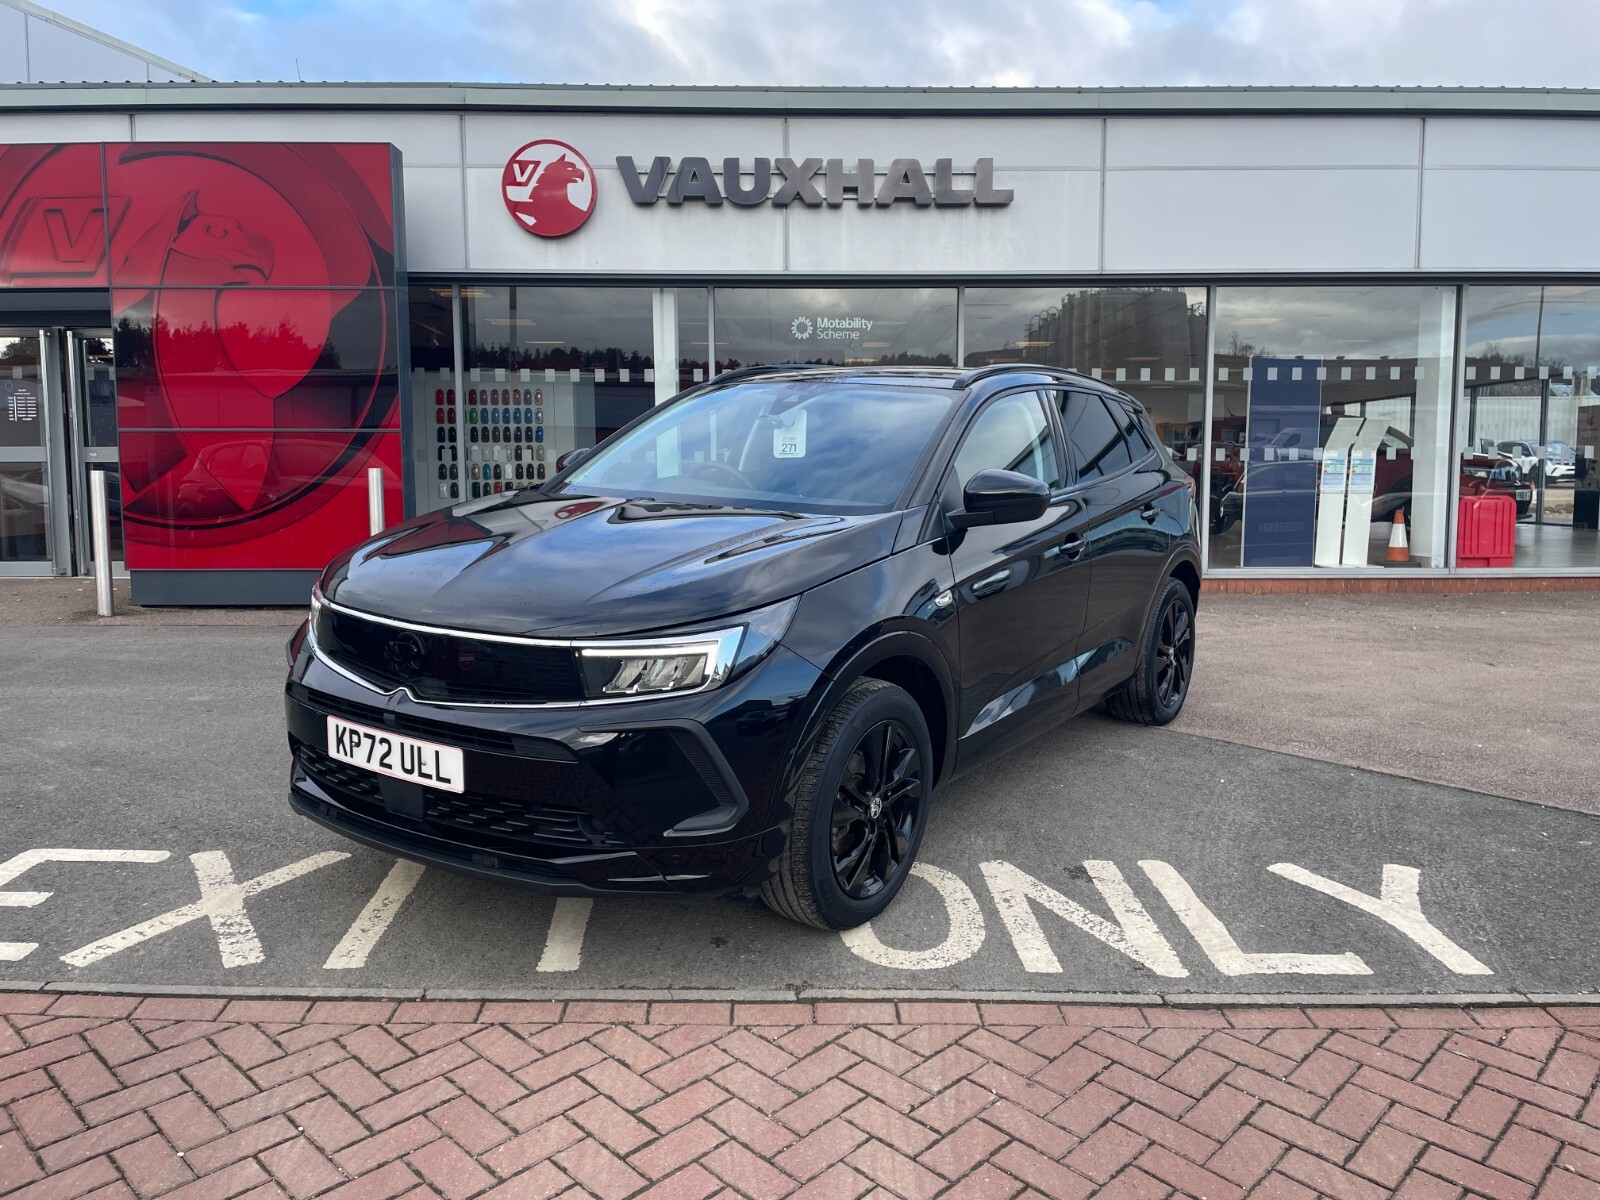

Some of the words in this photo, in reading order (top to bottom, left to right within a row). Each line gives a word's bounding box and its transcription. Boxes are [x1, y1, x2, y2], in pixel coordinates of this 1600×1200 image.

[513, 163, 535, 183] V
[615, 156, 1015, 208] VAUXHALL
[817, 317, 873, 331] Motability
[817, 328, 860, 340] Scheme
[781, 443, 797, 453] 271
[335, 724, 393, 770] KP72
[400, 742, 452, 785] ULL
[838, 860, 1494, 978] ONLY
